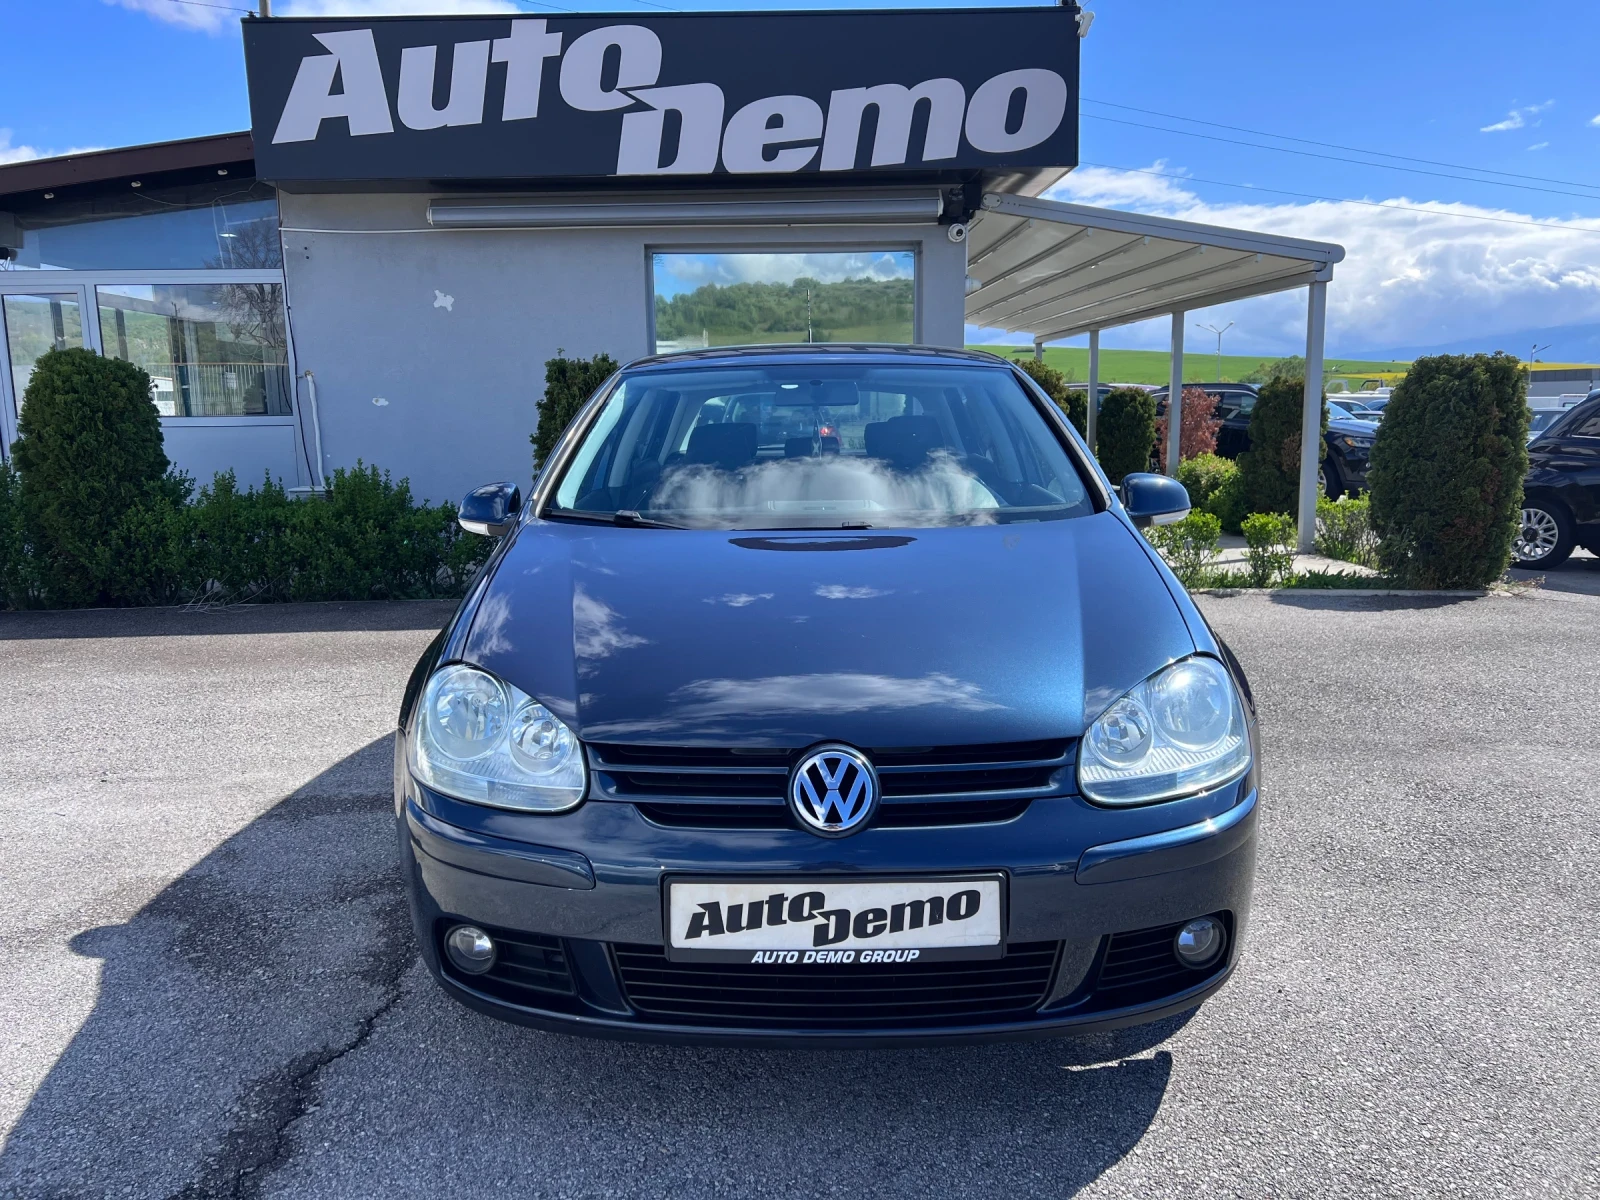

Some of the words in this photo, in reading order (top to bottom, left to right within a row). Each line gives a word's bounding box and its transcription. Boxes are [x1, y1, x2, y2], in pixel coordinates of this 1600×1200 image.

[272, 19, 662, 144] Auto
[616, 68, 1066, 176] Demo
[685, 891, 826, 939] Auto
[813, 889, 980, 947] Demo
[751, 950, 799, 964] AUTO
[802, 950, 855, 964] DEMO
[859, 950, 920, 963] GROUP
